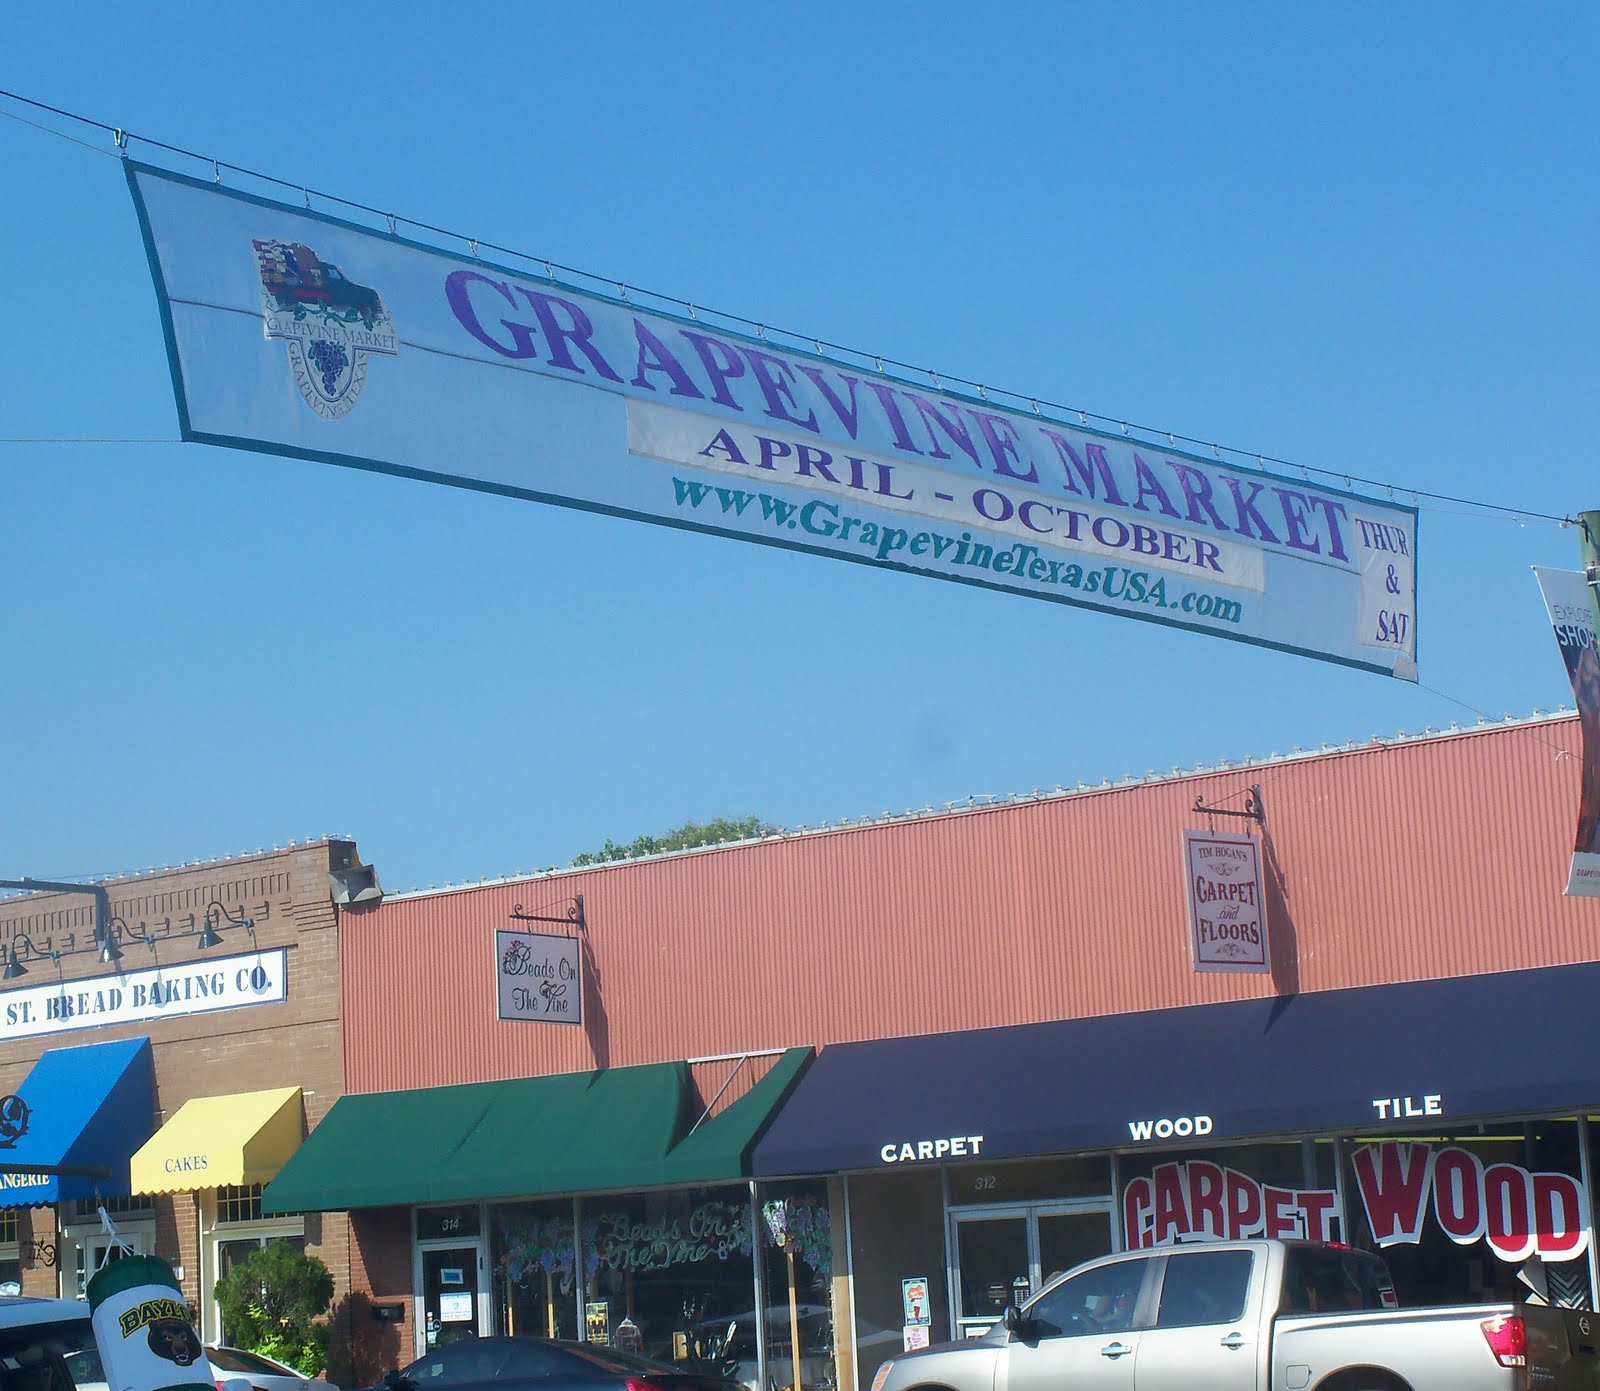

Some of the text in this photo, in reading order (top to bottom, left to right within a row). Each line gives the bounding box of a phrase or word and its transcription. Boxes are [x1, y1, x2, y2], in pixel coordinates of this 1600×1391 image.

[266, 317, 397, 349] GRAPEVINE MARKET
[345, 351, 368, 405] TEXAS
[445, 270, 1349, 563] GRAPEVINE MARKET
[698, 428, 915, 501] APRIL
[972, 489, 1225, 574] OCTOBER
[672, 476, 1243, 624] www.GrapevineTexasUSA.com
[1355, 518, 1410, 557] THUR
[1385, 564, 1401, 595] &
[1375, 609, 1410, 644] SAT
[1555, 624, 1596, 651] SHOP
[1198, 847, 1213, 859] TIM
[1196, 875, 1255, 906] CARPET
[1217, 904, 1240, 920] and
[1199, 917, 1260, 946] FLOORS
[504, 944, 576, 981] Beads On
[6, 964, 273, 1026] ST. BREAD BAKING CO.
[511, 980, 569, 1013] The Vine
[881, 1094, 1443, 1163] CARPET WOOD TILE
[165, 1154, 208, 1173] CAKES
[974, 1175, 997, 1191] 312
[1123, 1140, 1589, 1263] CARPET WOOD
[442, 1217, 460, 1231] 314
[118, 1298, 194, 1339] BAYLO
